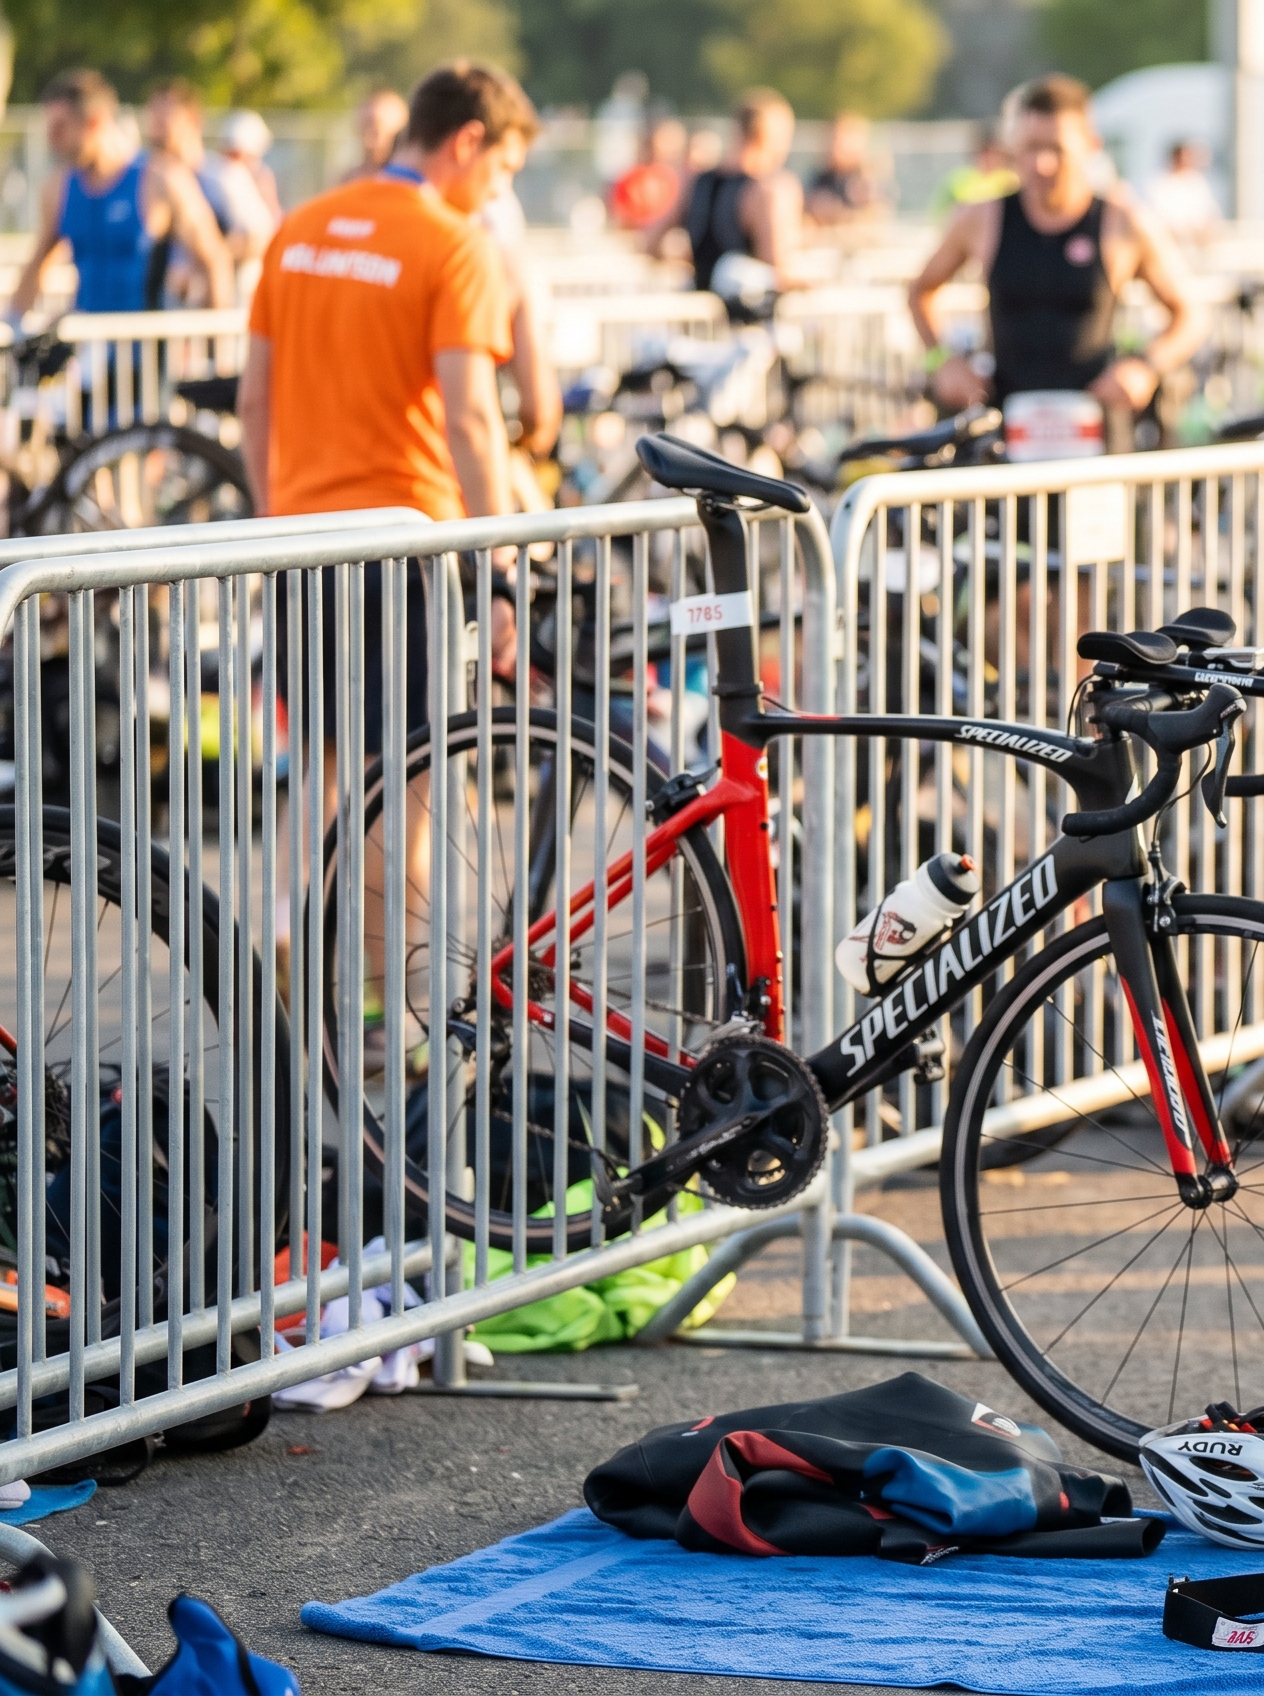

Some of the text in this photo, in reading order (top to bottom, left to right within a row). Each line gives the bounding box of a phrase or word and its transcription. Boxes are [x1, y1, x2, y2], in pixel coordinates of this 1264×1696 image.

[954, 725, 1073, 763] SPECIALIZED
[840, 854, 1058, 1077] SPECIALIZED
[1178, 1441, 1243, 1456] RUDY
